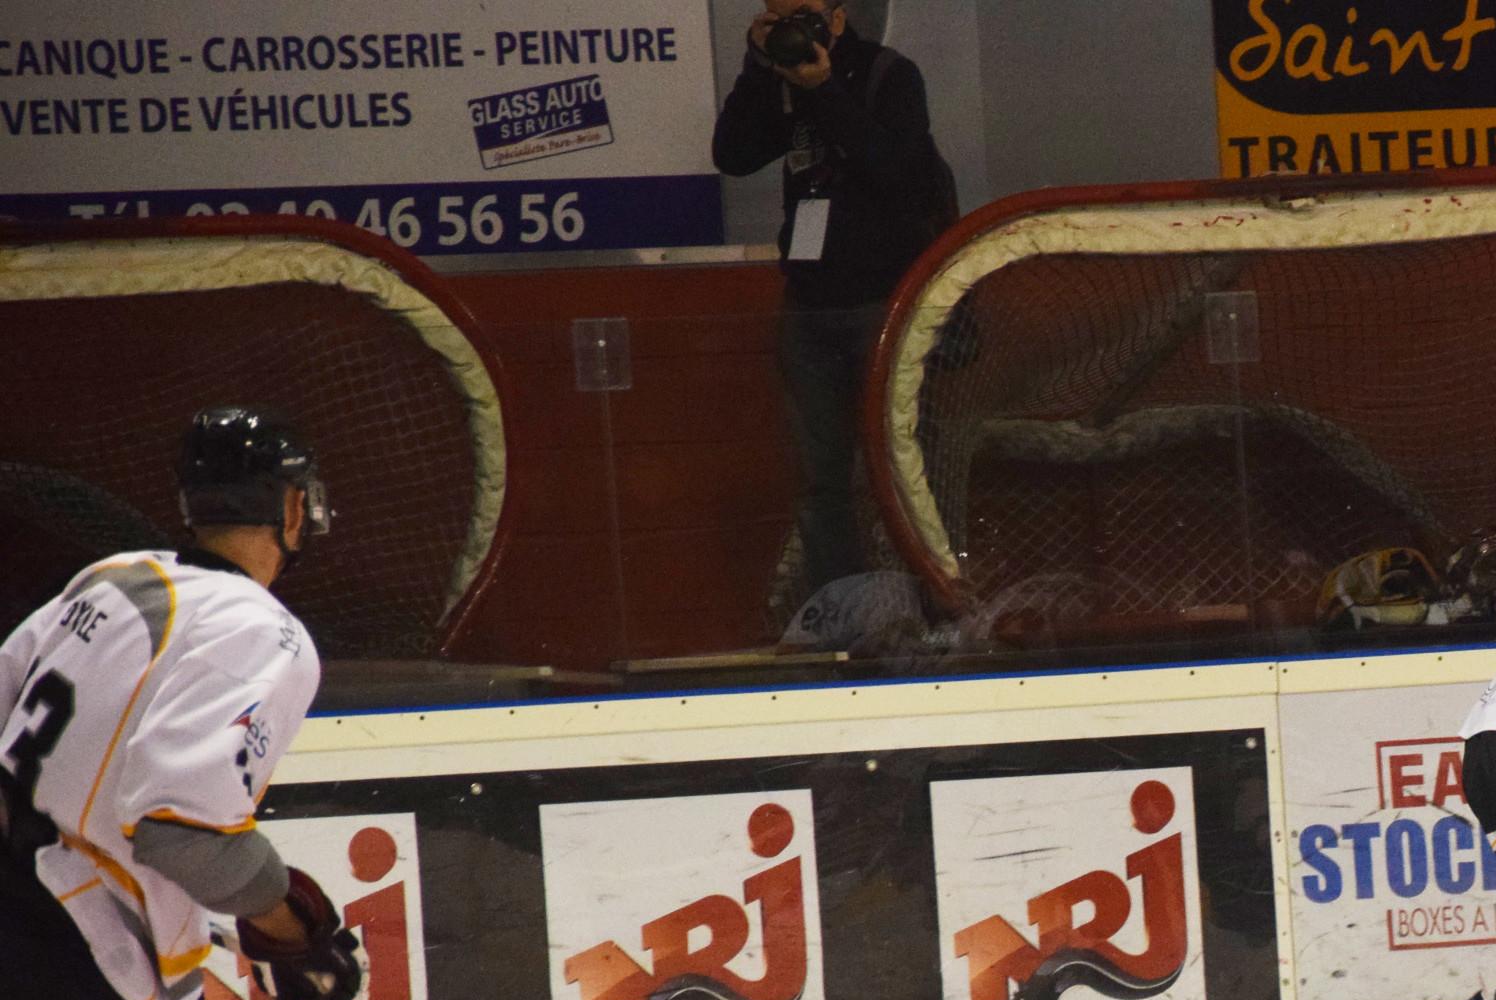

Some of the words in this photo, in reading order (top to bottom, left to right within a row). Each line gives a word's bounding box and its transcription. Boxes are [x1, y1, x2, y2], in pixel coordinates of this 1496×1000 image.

[201, 33, 464, 74] CARROSSERIE
[495, 27, 678, 67] PEINTURE
[1229, 0, 1496, 82] Saint
[0, 97, 130, 136] VENTE
[140, 96, 193, 133] DE
[198, 88, 413, 132] VÉHICULES
[467, 90, 541, 127] GLASS
[545, 76, 605, 111] AUTO
[500, 108, 583, 139] SERVICE
[356, 197, 422, 248] 46
[438, 194, 505, 246] 56
[520, 191, 586, 244] 56
[1399, 904, 1466, 939] BOXES
[1472, 905, 1491, 935] A
